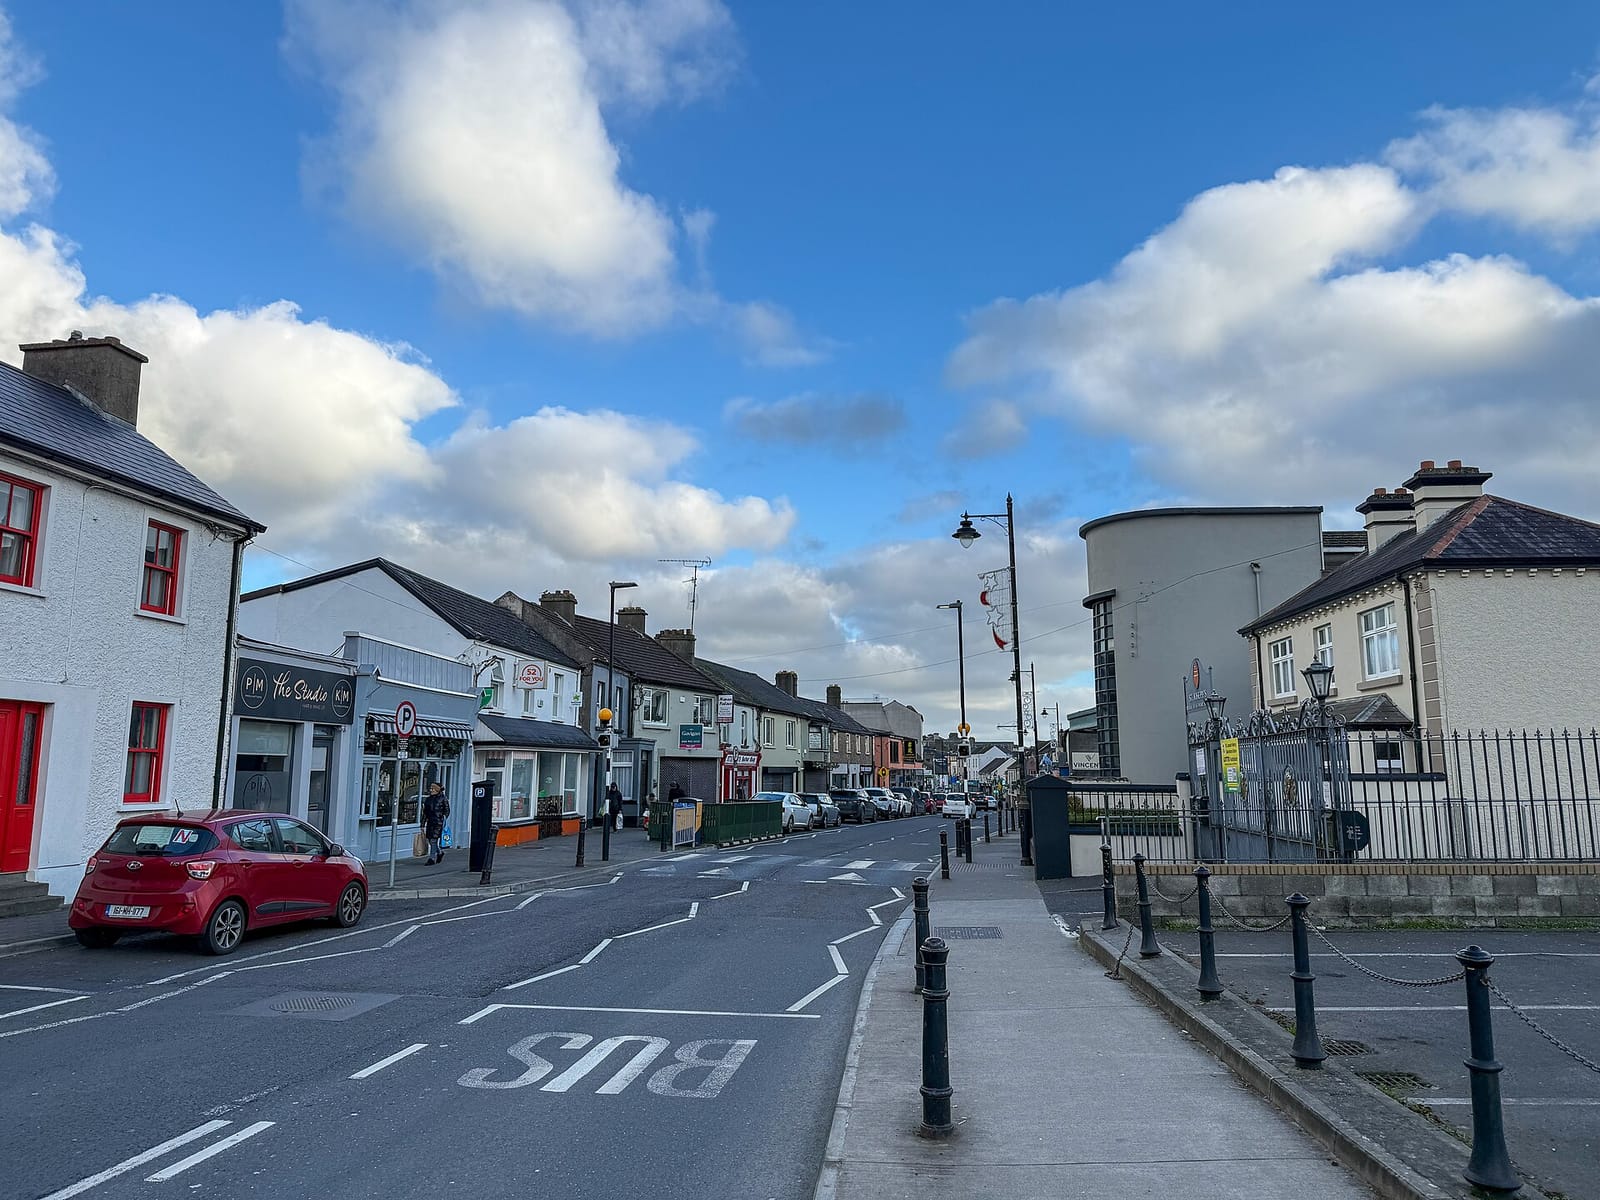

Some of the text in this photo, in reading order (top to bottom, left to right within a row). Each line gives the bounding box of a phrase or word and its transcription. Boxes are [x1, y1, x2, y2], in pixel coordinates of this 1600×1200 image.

[526, 668, 537, 676] 52
[272, 671, 328, 702] The Studio
[401, 707, 412, 731] P
[174, 829, 192, 843] N
[456, 1031, 758, 1098] BUS
